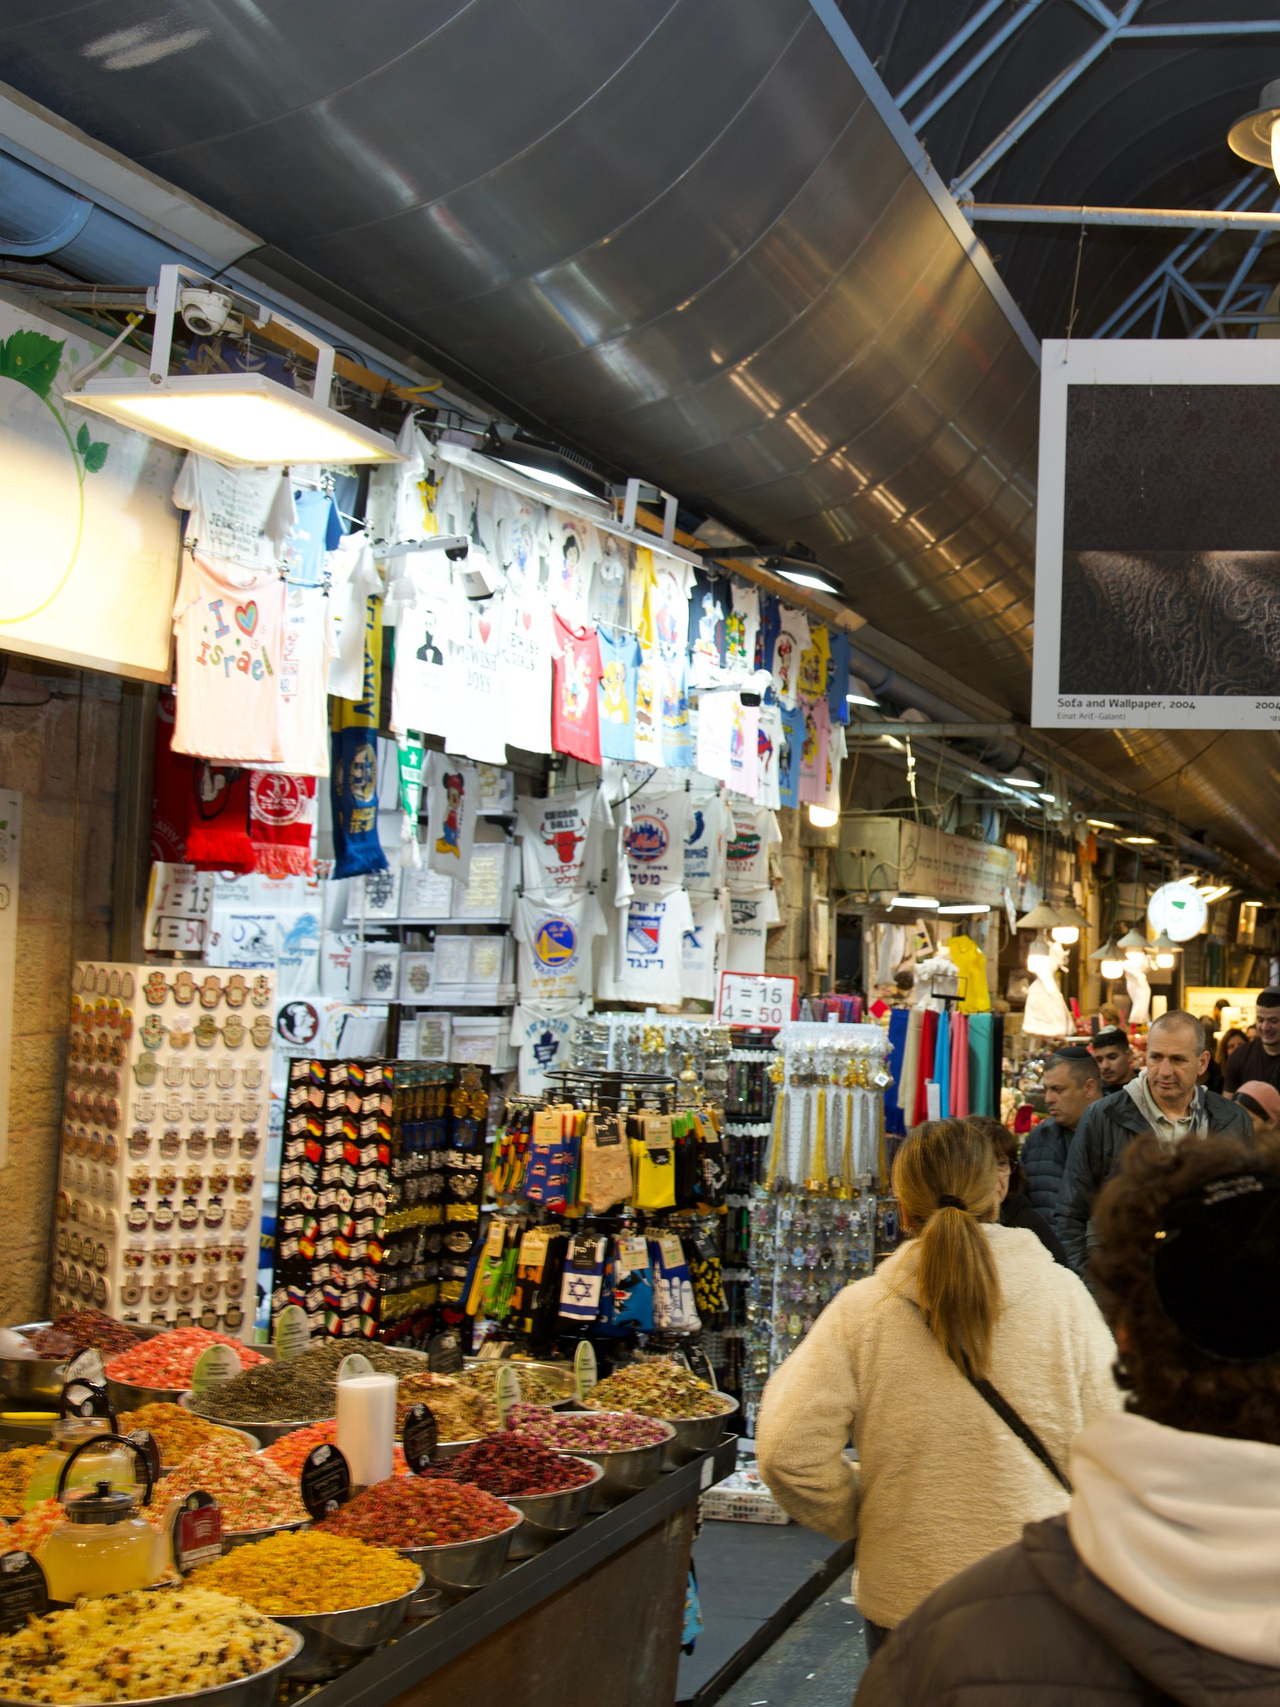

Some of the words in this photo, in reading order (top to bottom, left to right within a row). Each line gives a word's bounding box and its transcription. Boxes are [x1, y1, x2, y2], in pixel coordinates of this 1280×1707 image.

[208, 599, 230, 639] I
[196, 641, 274, 681] Israel
[1057, 698, 1083, 708] Sofa
[1086, 699, 1105, 708] and
[1109, 699, 1166, 710] Wallpaper,
[1057, 712, 1077, 720] Einat
[1079, 712, 1126, 720] Arif-Galanti
[630, 804, 646, 814] יור
[188, 887, 211, 914] 15
[629, 902, 650, 912] יור
[184, 918, 208, 945] 50
[724, 985, 731, 999] 1
[759, 988, 782, 1003] 15
[722, 1005, 733, 1019] 4
[759, 1007, 782, 1023] 50
